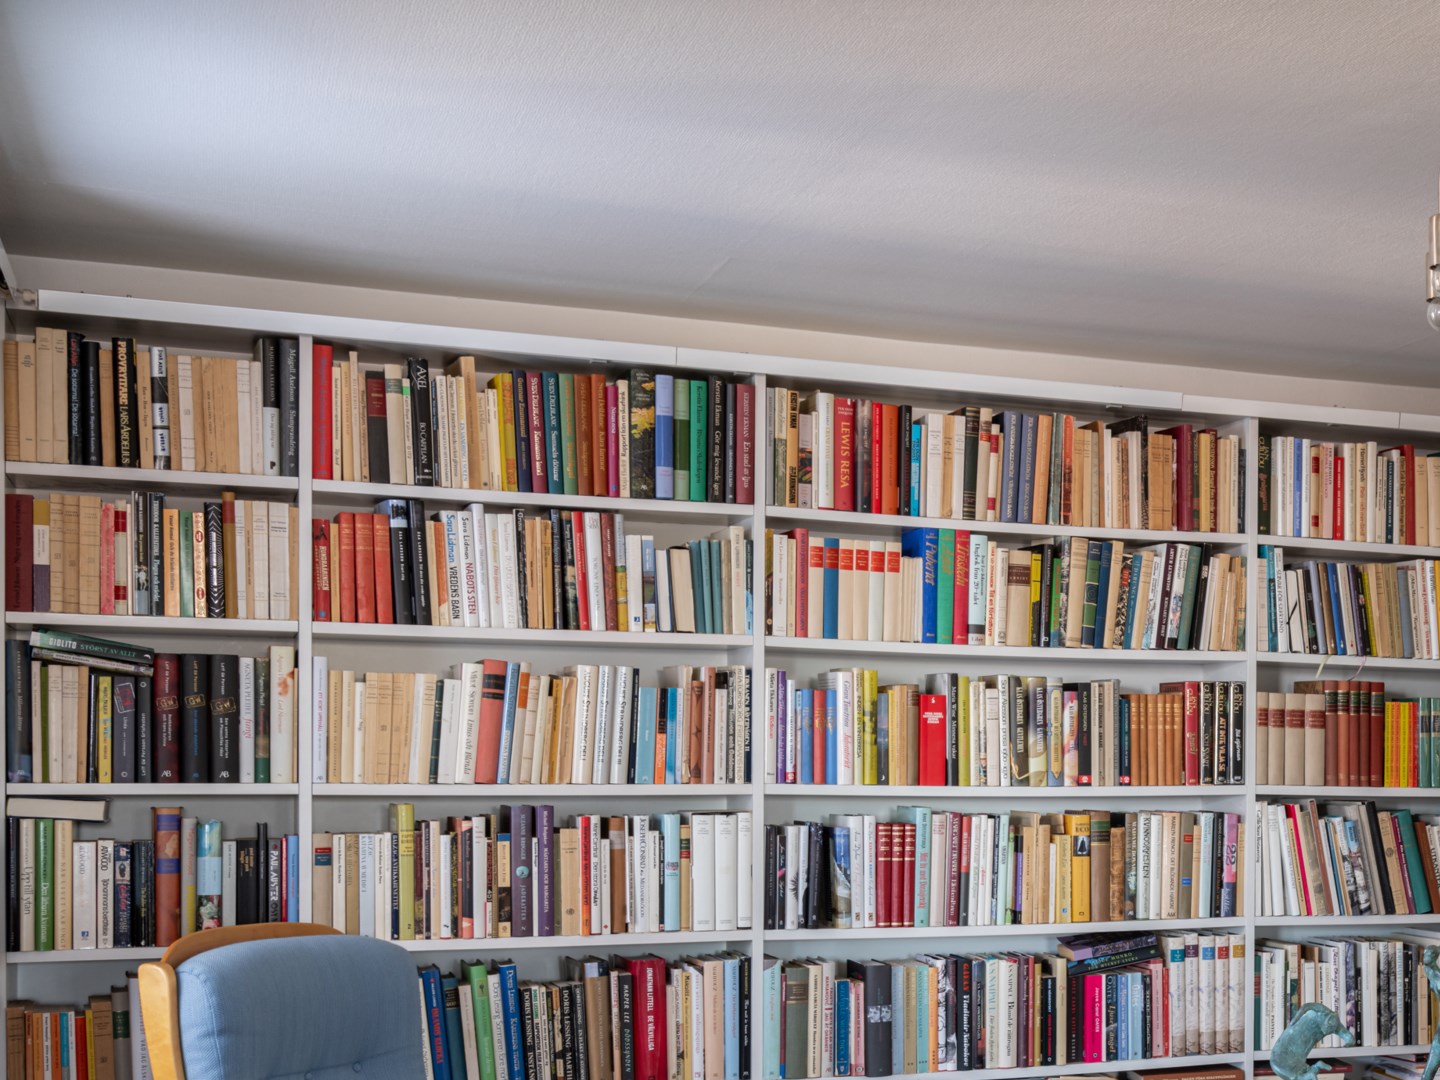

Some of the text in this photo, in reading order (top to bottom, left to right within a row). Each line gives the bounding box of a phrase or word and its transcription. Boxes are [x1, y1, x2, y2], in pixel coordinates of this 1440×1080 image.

[548, 378, 556, 393] SVEN
[714, 380, 722, 403] Kerstin
[118, 341, 132, 464] PROVRYTTARE LARS ARDELIUS
[288, 348, 296, 456] Majgull Axelsson Slumpvandring
[416, 366, 428, 463] AXEL BO CARPELAN
[549, 395, 557, 427] DELBLANC
[714, 405, 722, 426] Ekman
[534, 431, 544, 476] Kanaans land
[551, 430, 559, 457] Samuels
[742, 392, 751, 488] KERSTIN EKMAN En stad av ljus
[840, 421, 851, 488] LEWIS RESA
[712, 480, 720, 496] igen
[462, 535, 470, 560] Lidman
[320, 545, 329, 591] HUNDRAÅRINGEN
[446, 514, 460, 619] Sara Lidman VREDENS BARN
[465, 562, 473, 594] NABOTS
[924, 542, 936, 585] Pubertet
[956, 544, 966, 586] Tröskeln
[468, 596, 476, 614] STEN
[48, 638, 77, 649] GIOLITO
[100, 846, 108, 871] ATWOOD
[21, 866, 33, 882] Upp
[40, 882, 49, 894] Den
[271, 851, 279, 900] PAUL AUSTER
[21, 897, 33, 915] ytan
[41, 916, 49, 942] kvinnan
[646, 967, 654, 992] JONATHAN
[562, 990, 570, 1013] DORIS
[525, 1016, 533, 1046] LESSING
[563, 1016, 572, 1048] LESSING
[647, 1023, 656, 1051] VÄLVILLIGA
[962, 1032, 970, 1066] Nabokov
